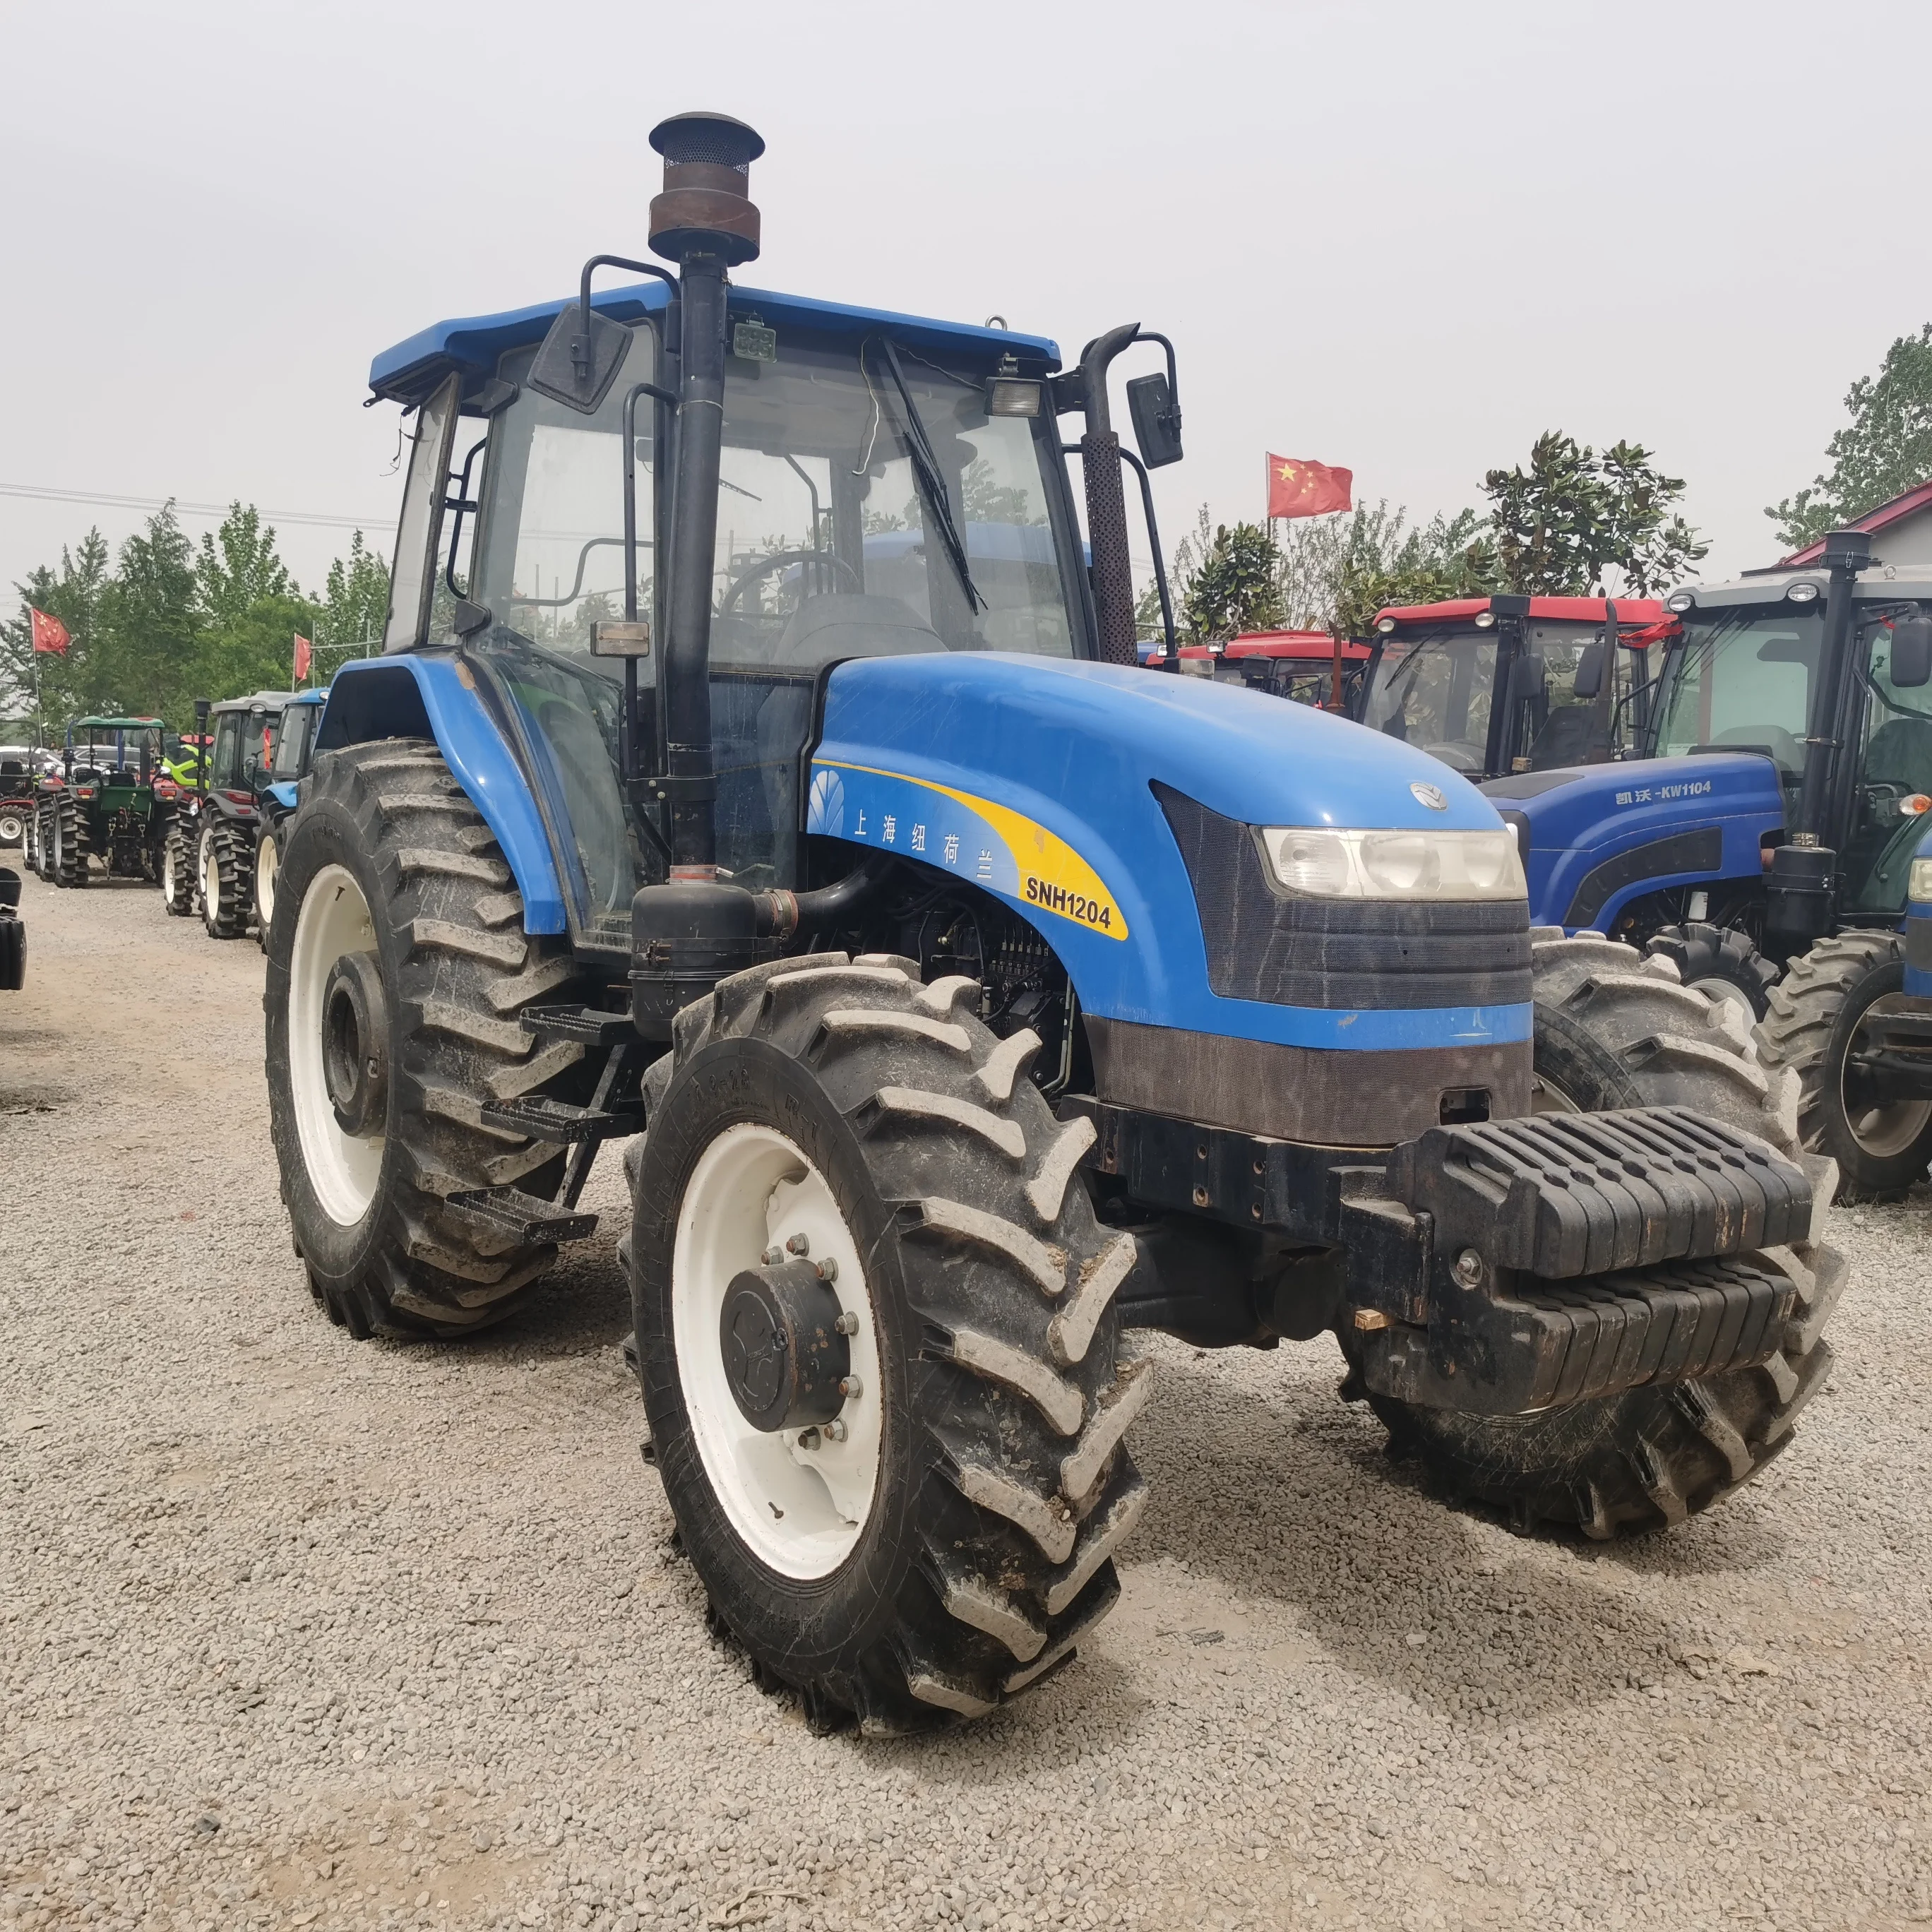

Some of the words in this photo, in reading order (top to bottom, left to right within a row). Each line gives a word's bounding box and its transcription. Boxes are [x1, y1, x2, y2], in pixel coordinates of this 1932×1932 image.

[1615, 788, 1652, 805] 凯沃
[854, 809, 993, 879] 上海纽荷兰
[1025, 876, 1111, 929] SNH1204
